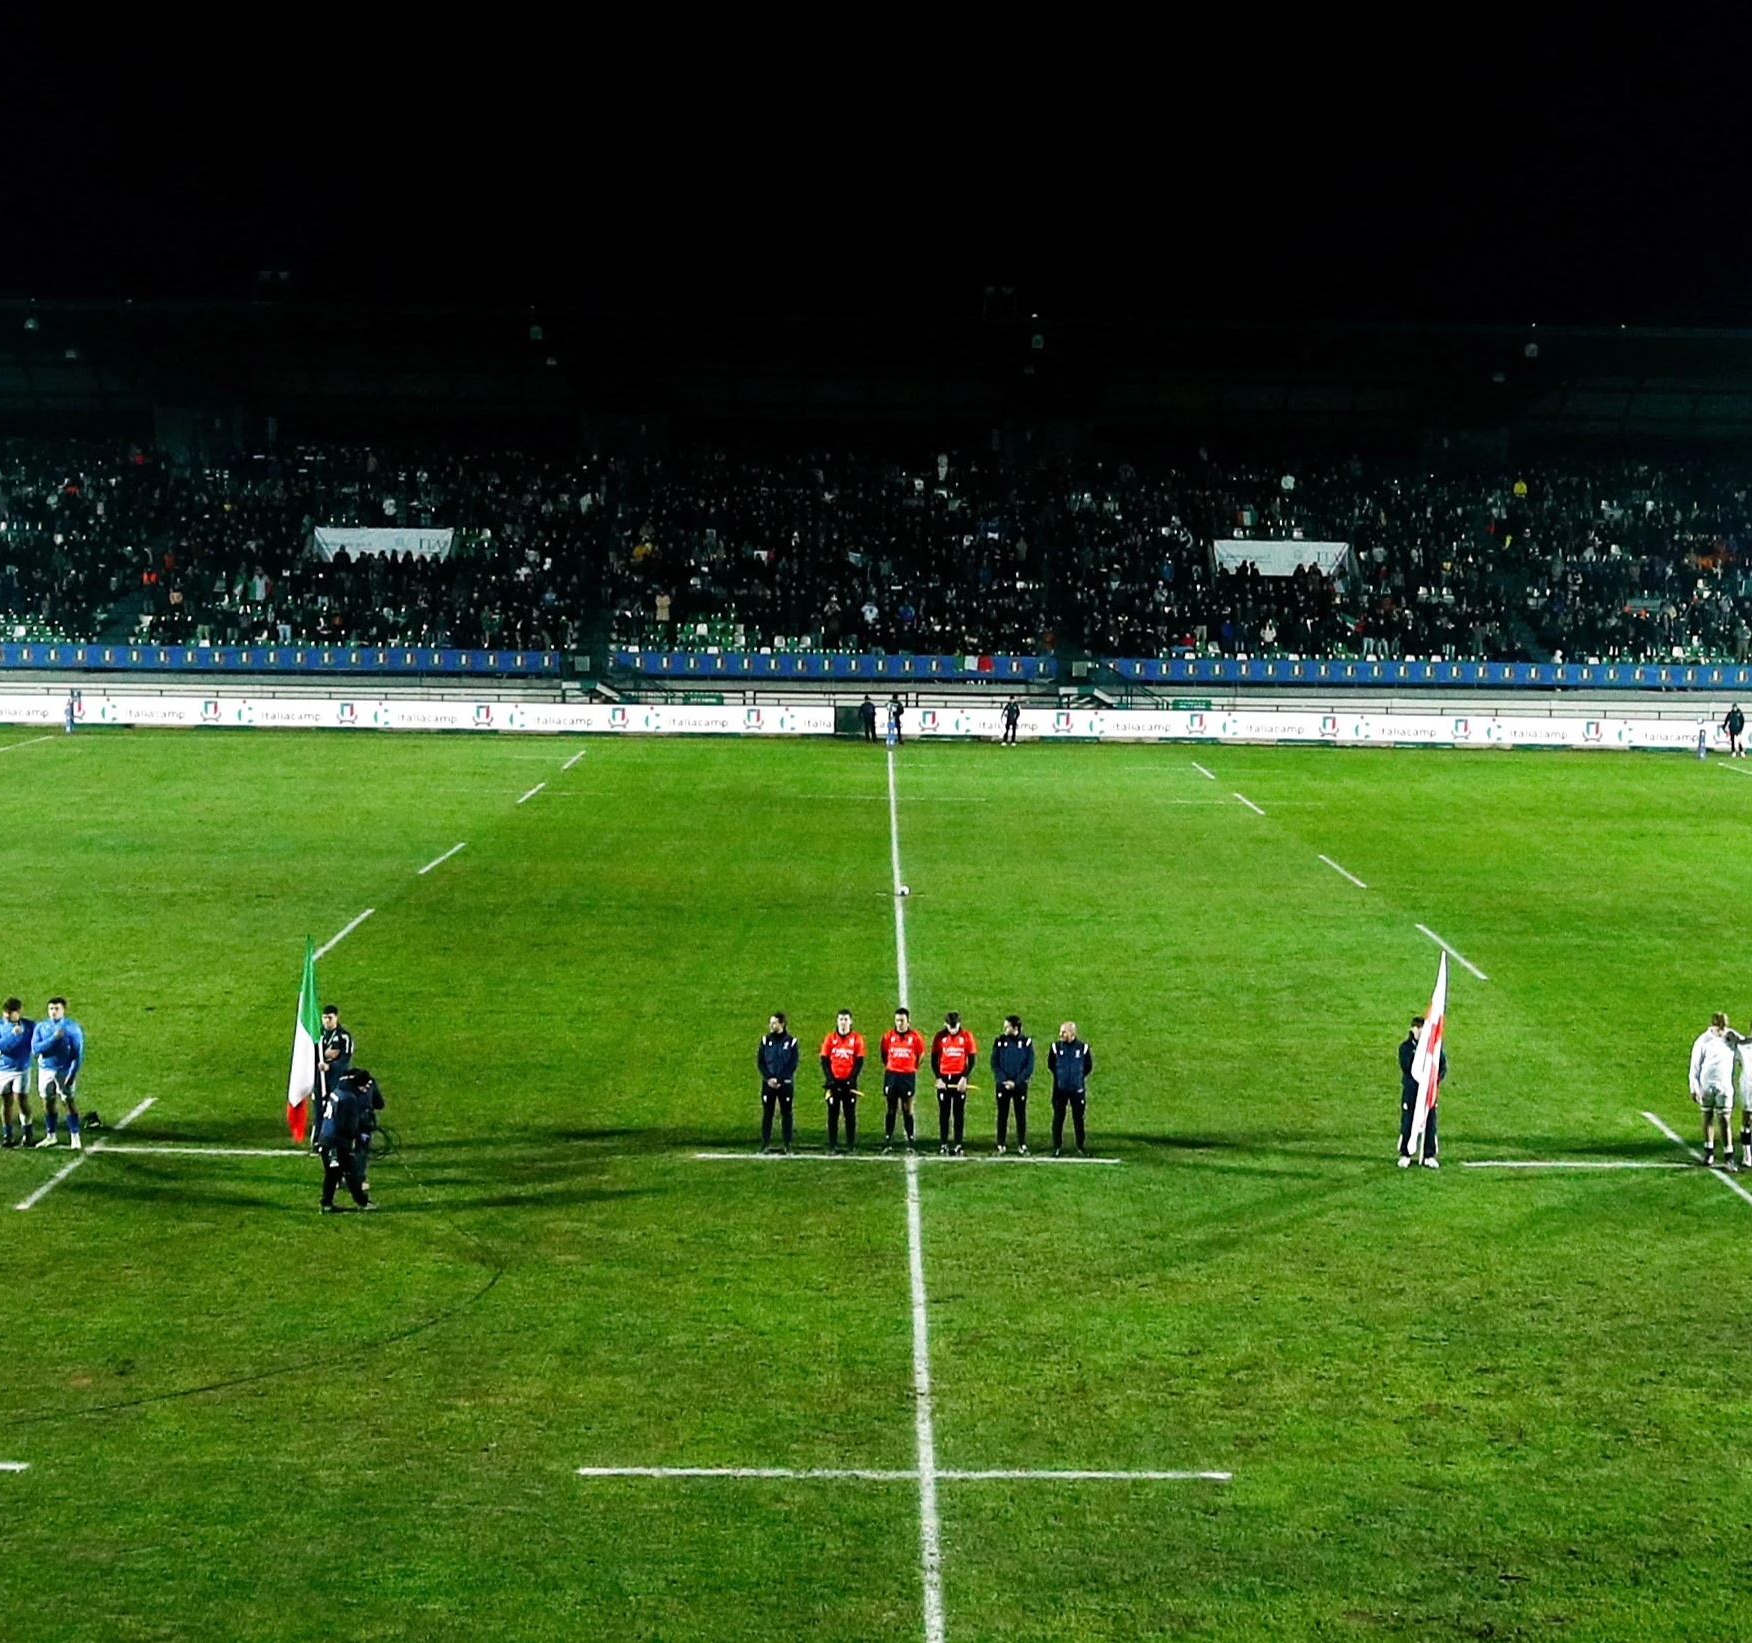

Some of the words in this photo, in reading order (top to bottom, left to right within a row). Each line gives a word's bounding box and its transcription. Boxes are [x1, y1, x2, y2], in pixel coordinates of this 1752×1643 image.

[125, 709, 185, 719] Italiacamp
[261, 711, 321, 721] Italiacamp
[397, 714, 457, 724] Italiacamp
[533, 716, 593, 726] Italiacamp
[668, 718, 729, 728] Italiacamp
[1112, 723, 1172, 733] Italiacamp
[1245, 725, 1305, 735] Italiacamp
[1378, 727, 1437, 738] Italiacamp
[1509, 730, 1568, 739] Italiacamp
[1641, 732, 1699, 742] Italiacamp
